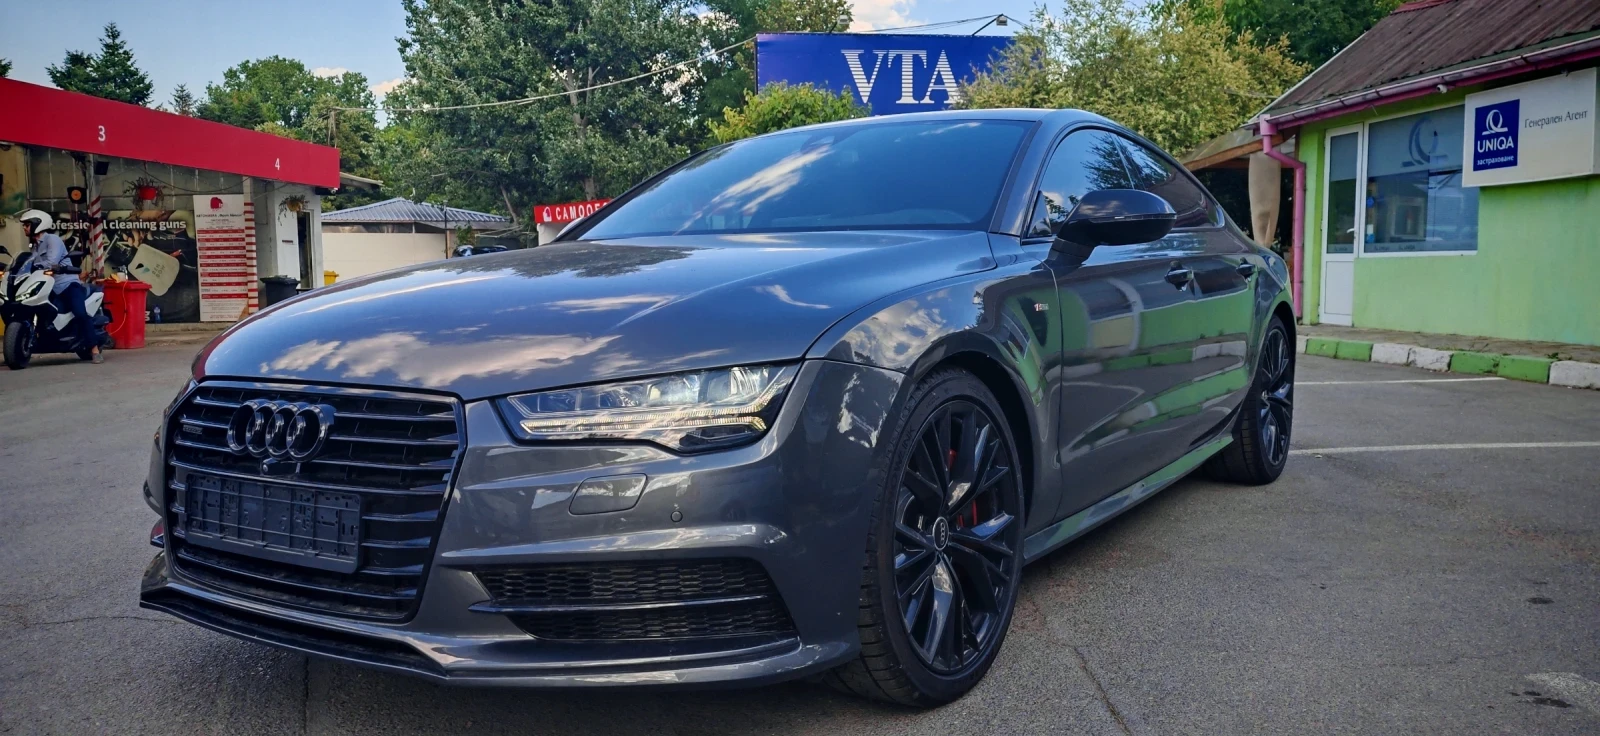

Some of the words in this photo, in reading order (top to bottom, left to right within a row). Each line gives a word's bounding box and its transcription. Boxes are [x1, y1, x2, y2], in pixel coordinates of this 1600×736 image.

[841, 49, 962, 104] VTA
[1524, 116, 1563, 129] Генерален
[1565, 110, 1588, 122] Агент
[98, 125, 106, 141] 3
[1477, 136, 1514, 153] UNIQA
[275, 157, 280, 170] 4
[1477, 155, 1514, 166] застраховане
[555, 202, 608, 220] САМОО
[51, 219, 107, 230] ofessiol
[109, 219, 157, 231] cleaning
[159, 221, 187, 231] guns
